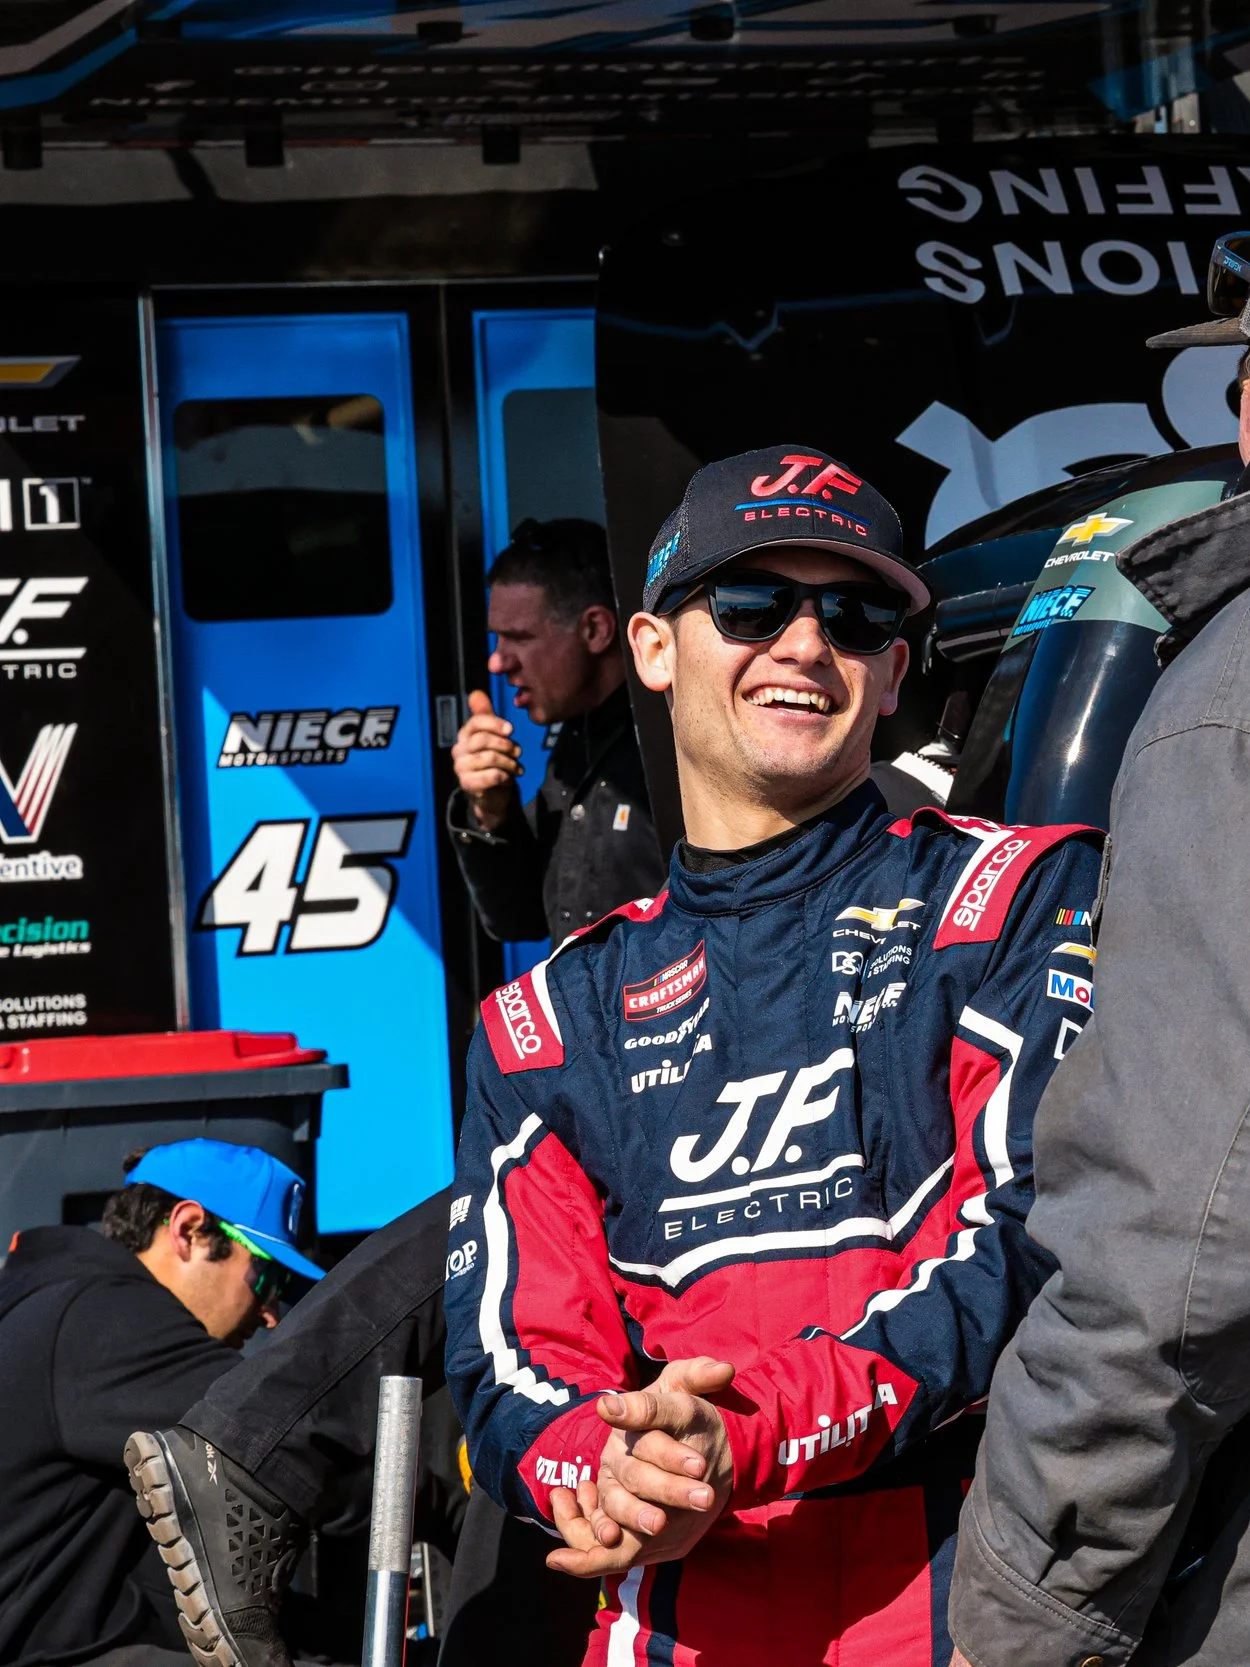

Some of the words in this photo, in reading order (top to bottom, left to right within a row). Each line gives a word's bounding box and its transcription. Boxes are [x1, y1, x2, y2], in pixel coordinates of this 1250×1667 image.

[744, 507, 867, 537] ELECTRIC
[1044, 550, 1116, 569] CHEVROLET
[1019, 586, 1093, 625] NIECE
[222, 706, 397, 754] NIECE
[217, 750, 347, 768] MOTORSPORTS
[197, 814, 413, 956] 45
[953, 839, 1027, 928] sparco
[0, 916, 89, 943] cision
[629, 957, 705, 1009] CRAFTSMAN
[662, 959, 689, 983] NASCAR
[0, 993, 87, 1013] OLUTIONS
[7, 1010, 88, 1030] STAFFING
[497, 981, 542, 1056] sparco
[664, 1177, 853, 1241] ELECTRIC
